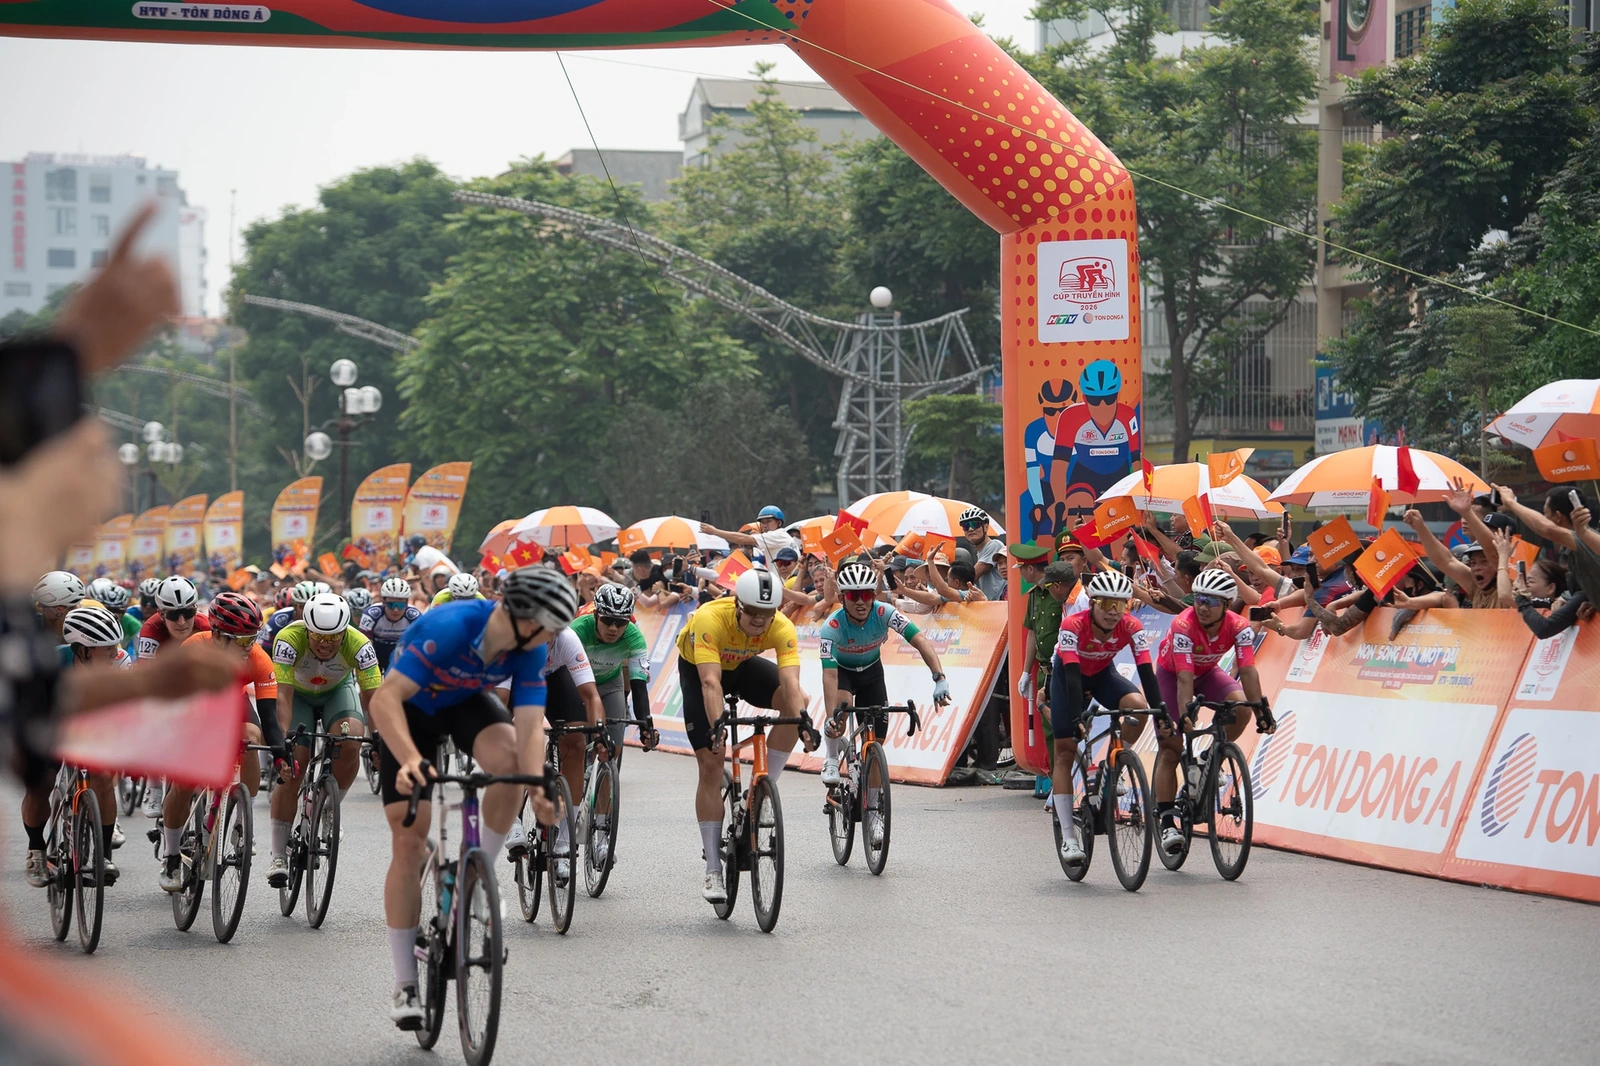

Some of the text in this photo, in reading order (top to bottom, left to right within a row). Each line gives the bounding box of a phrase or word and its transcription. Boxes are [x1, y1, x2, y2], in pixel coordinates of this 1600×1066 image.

[139, 6, 168, 16] HTV
[181, 6, 209, 18] TÔN
[213, 7, 250, 20] ĐÔNG
[253, 8, 263, 20] Á
[1053, 292, 1070, 300] CÚP
[1046, 314, 1078, 325] HTV
[1566, 465, 1585, 473] DONG
[1322, 549, 1333, 559] TON
[1331, 543, 1345, 555] DONG
[1375, 567, 1387, 579] TON
[1385, 555, 1398, 571] DONG
[361, 617, 372, 627] 97
[892, 613, 904, 627] 26
[1061, 633, 1074, 646] 85
[140, 641, 158, 653] 127
[1355, 644, 1376, 660] NON
[1278, 742, 1462, 828] TON DONG A
